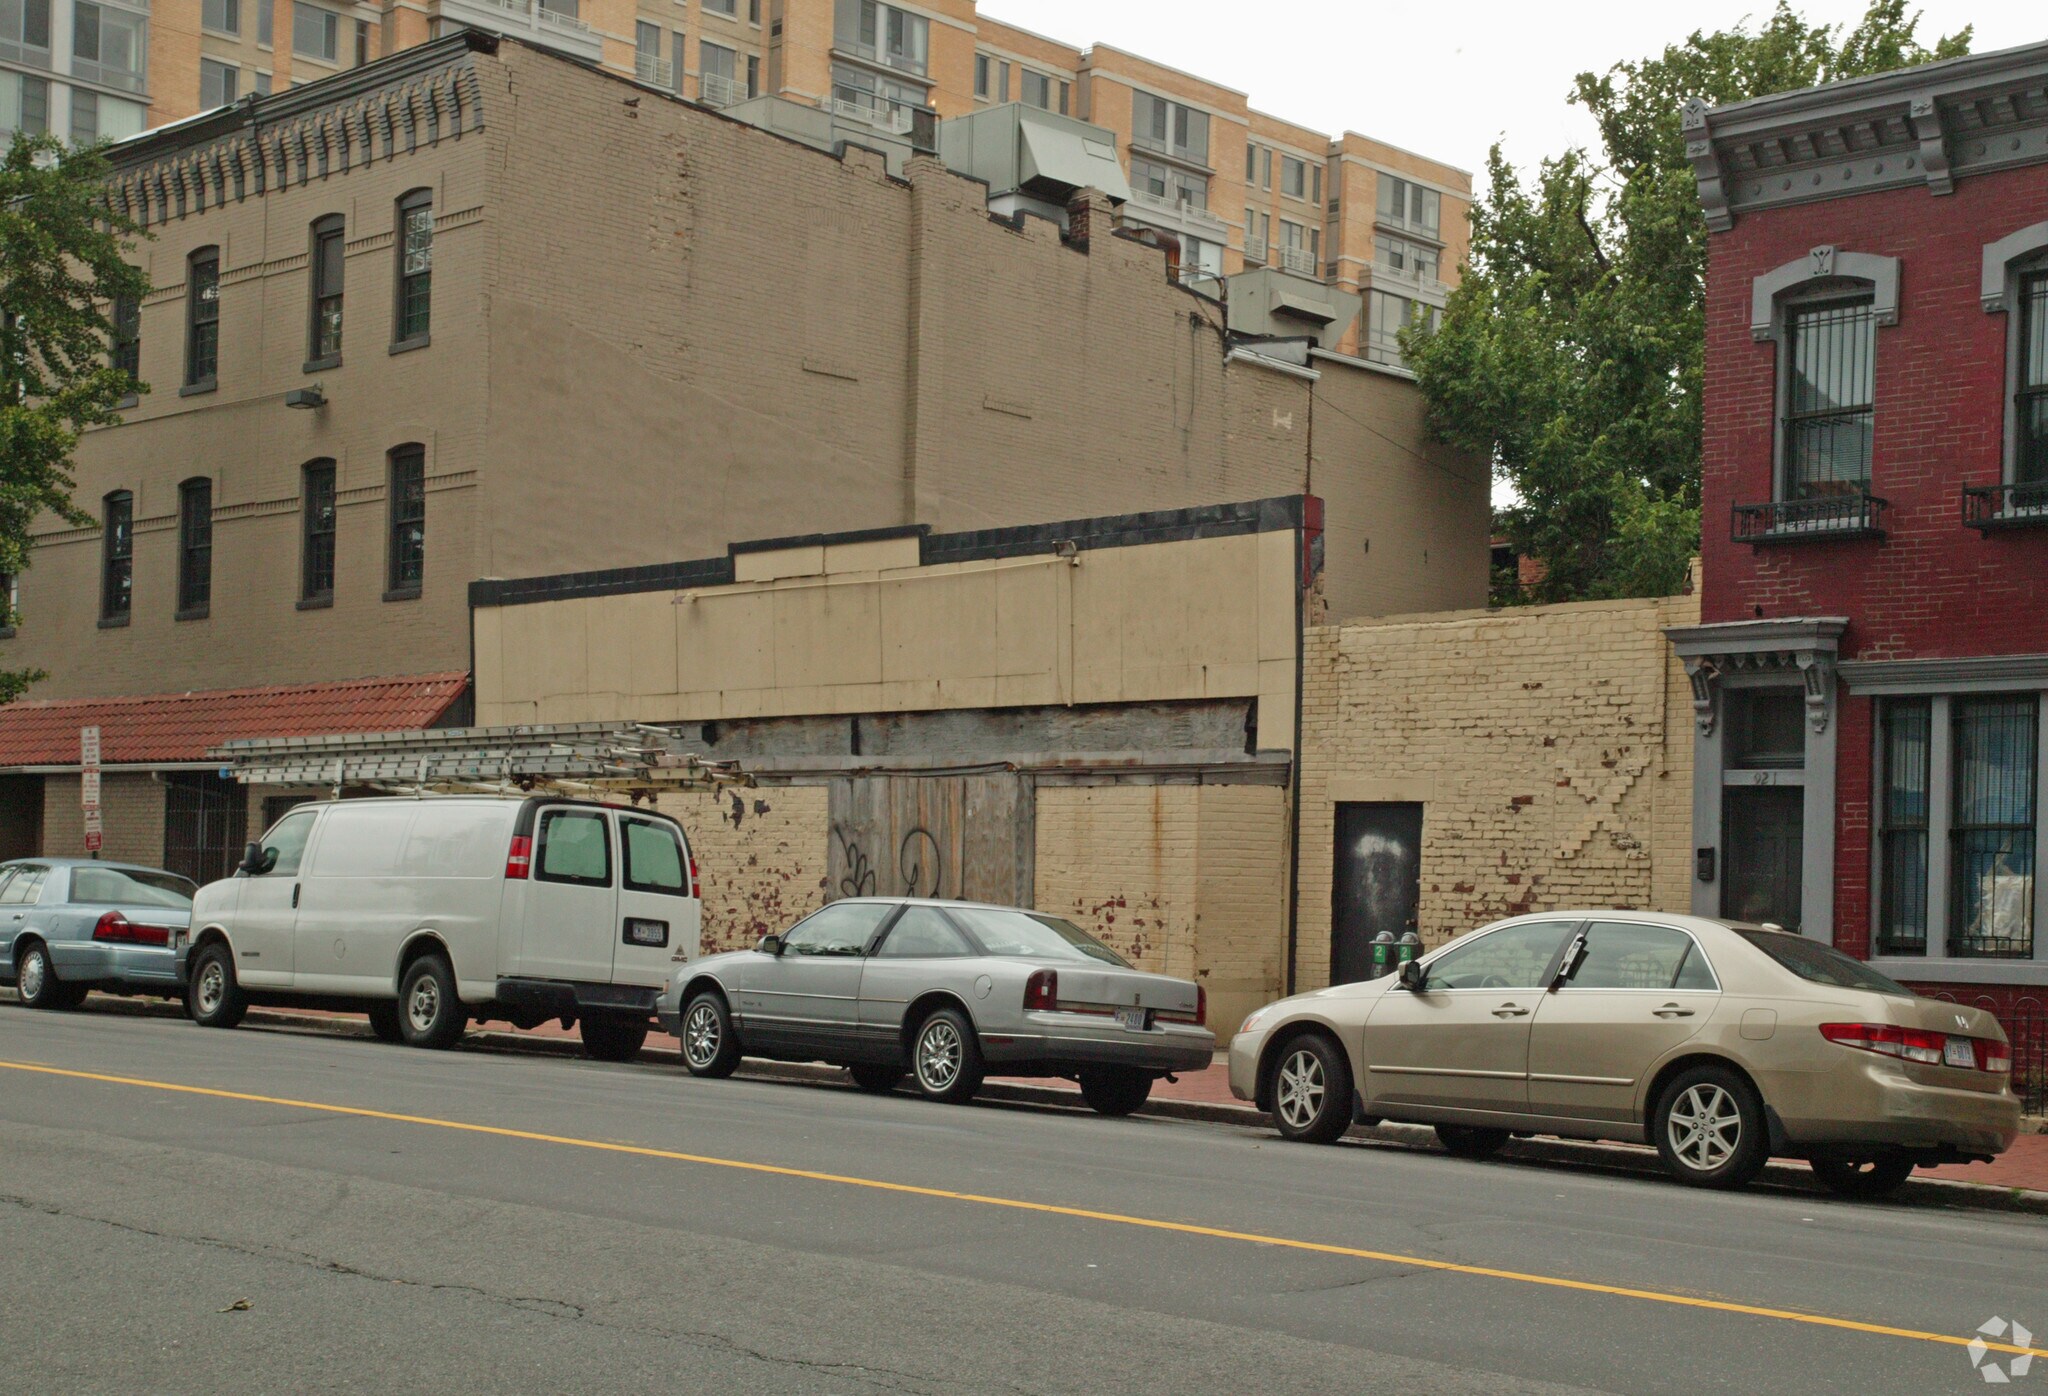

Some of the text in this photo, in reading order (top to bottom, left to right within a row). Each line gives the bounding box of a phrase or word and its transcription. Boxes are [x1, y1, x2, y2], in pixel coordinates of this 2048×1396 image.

[1754, 771, 1777, 785] 921
[1375, 945, 1383, 957] 2
[1401, 946, 1408, 958] 2
